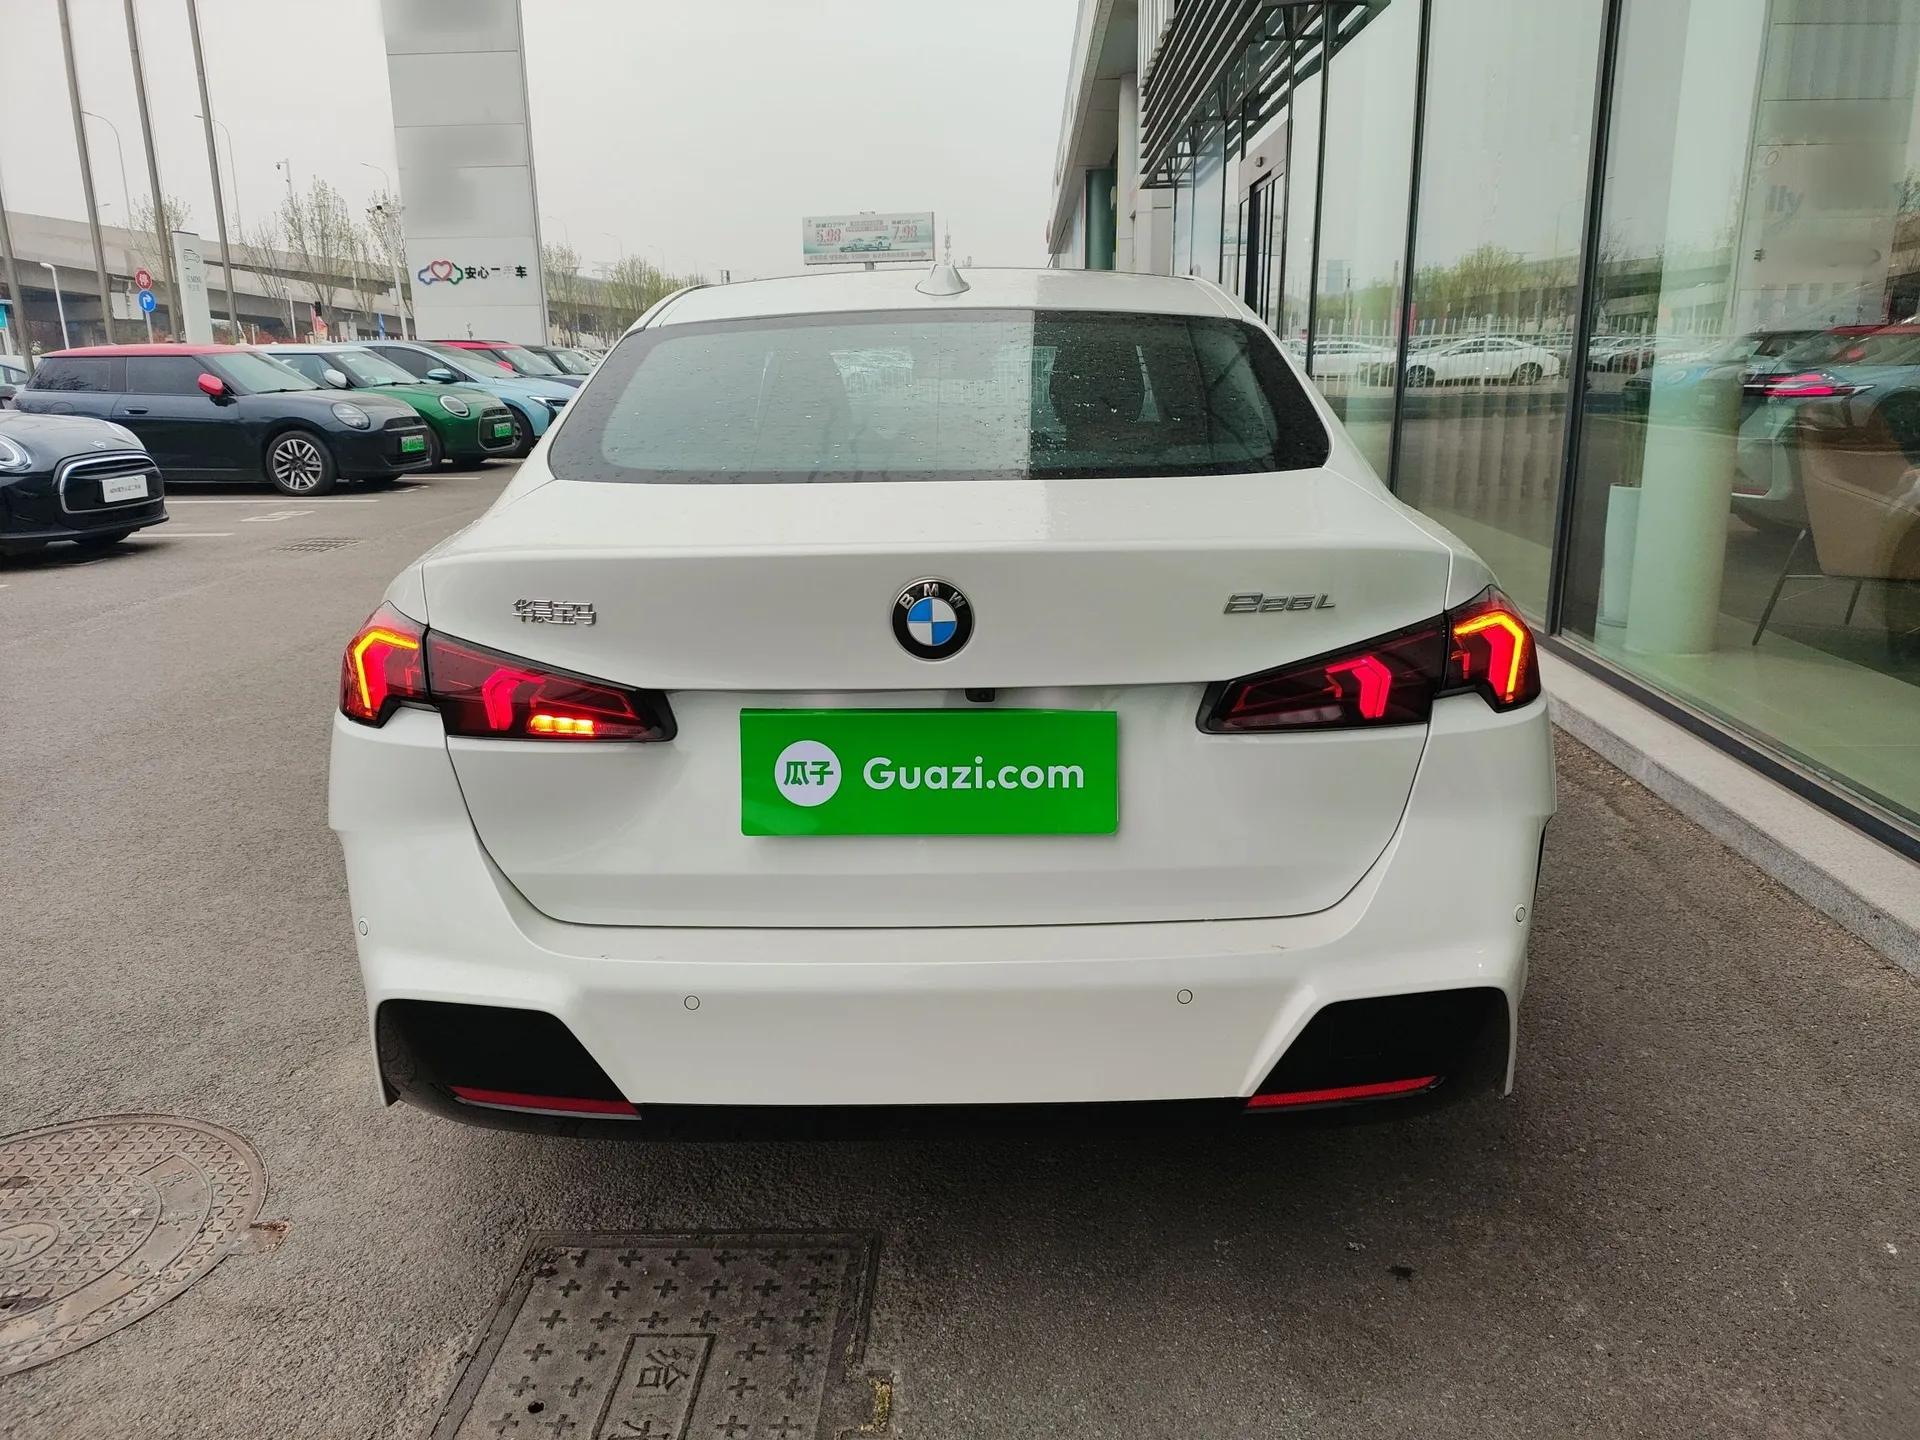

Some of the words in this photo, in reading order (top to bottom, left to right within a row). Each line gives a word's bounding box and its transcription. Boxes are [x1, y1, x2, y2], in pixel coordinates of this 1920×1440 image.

[898, 583, 967, 610] BMW
[511, 599, 597, 626] 华晨宝马
[783, 761, 834, 786] 瓜子
[862, 755, 1085, 790] Guazi.com
